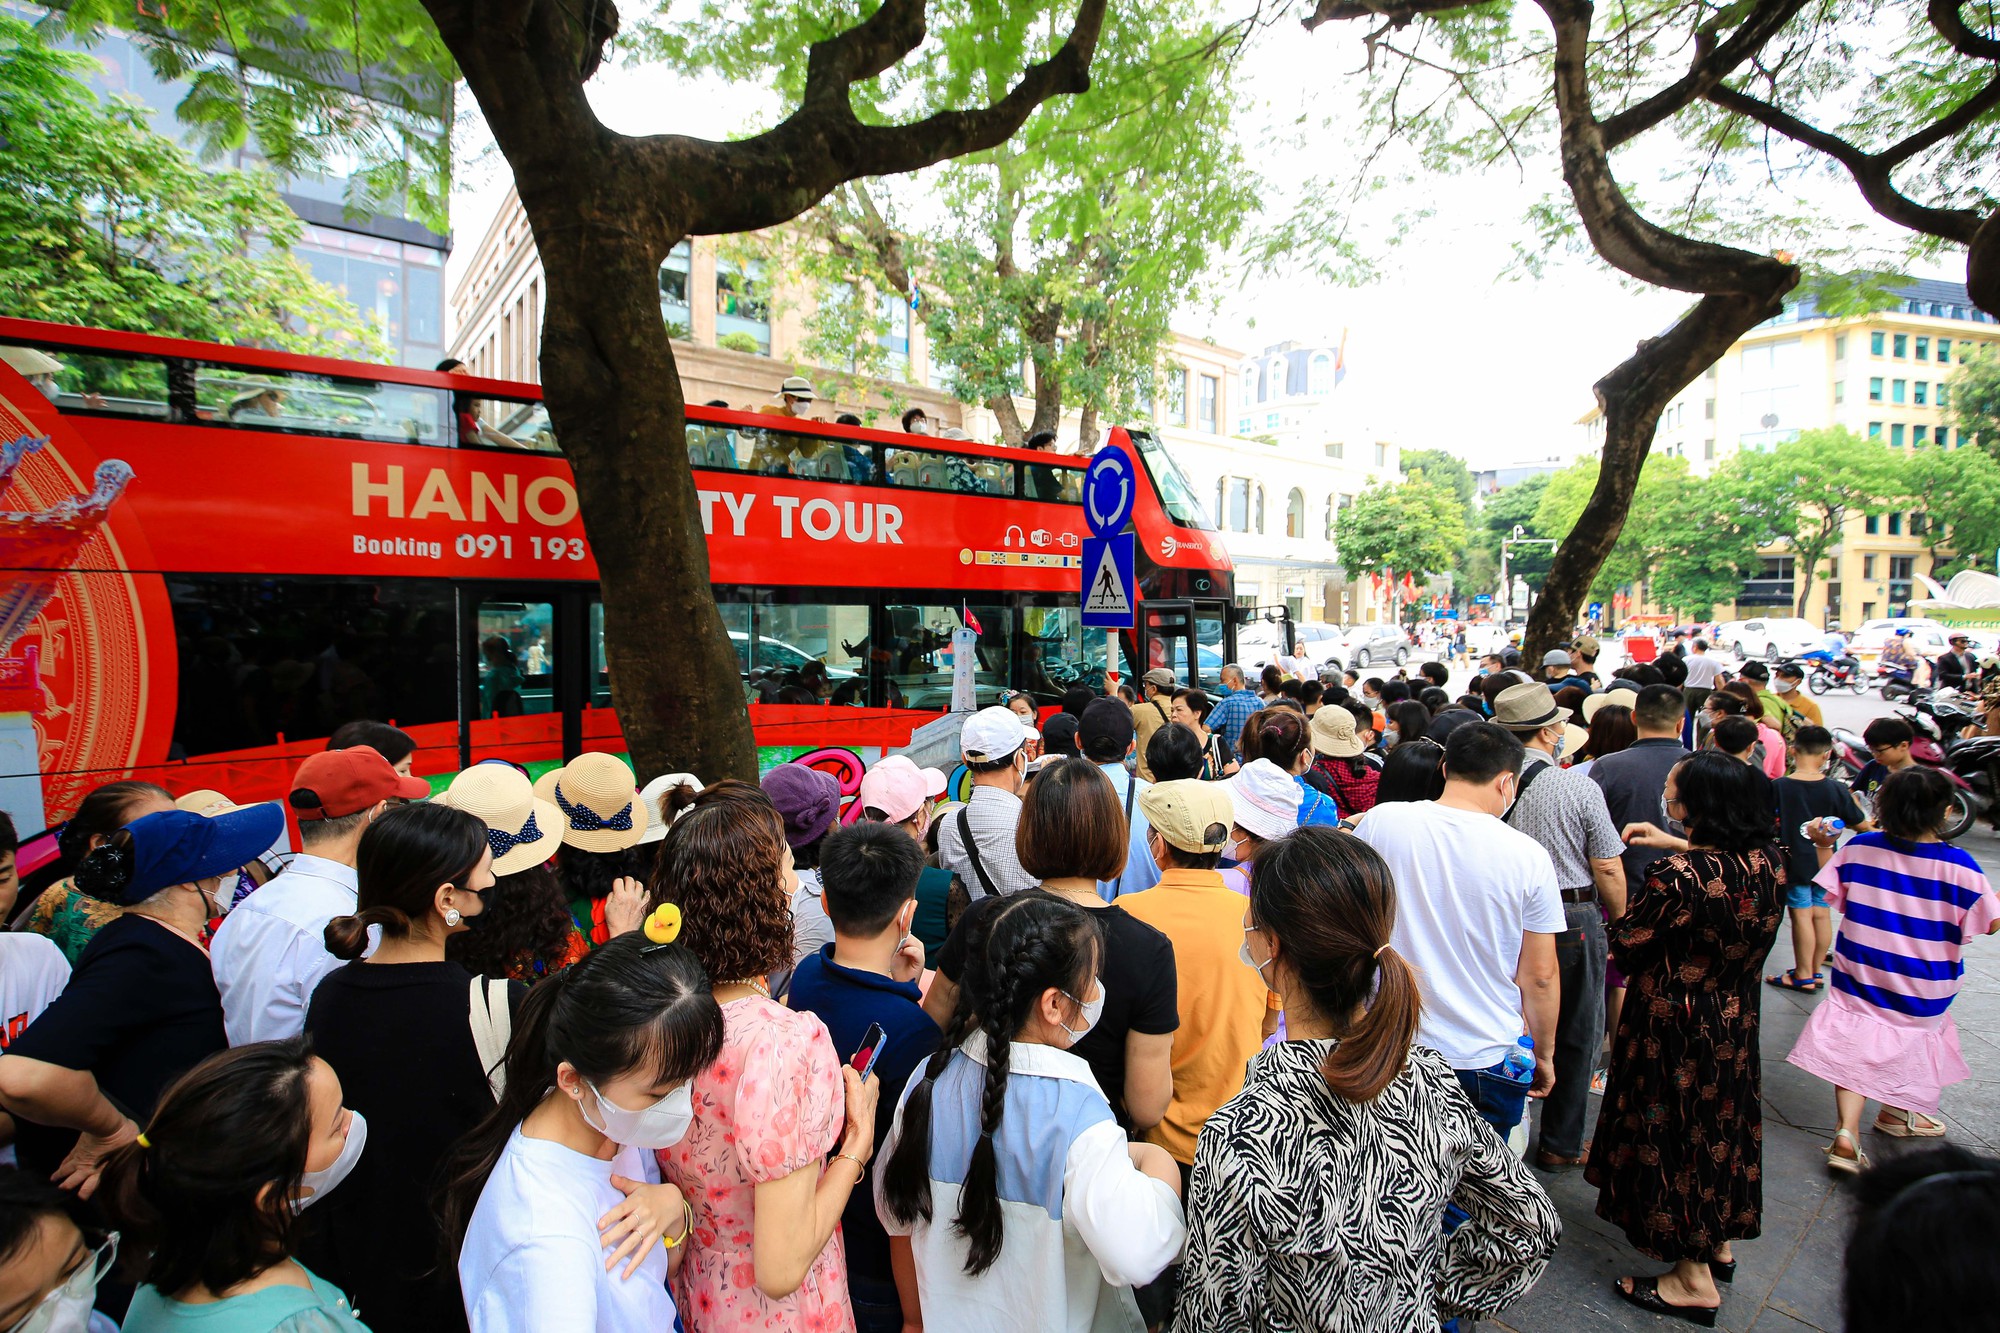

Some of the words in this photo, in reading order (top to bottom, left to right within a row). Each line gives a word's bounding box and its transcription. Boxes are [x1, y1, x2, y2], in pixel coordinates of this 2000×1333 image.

[352, 462, 579, 527] HANO
[697, 490, 756, 537] TY
[773, 496, 903, 544] TOUR
[353, 535, 441, 559] Booking
[456, 534, 512, 559] 091
[530, 537, 585, 560] 193
